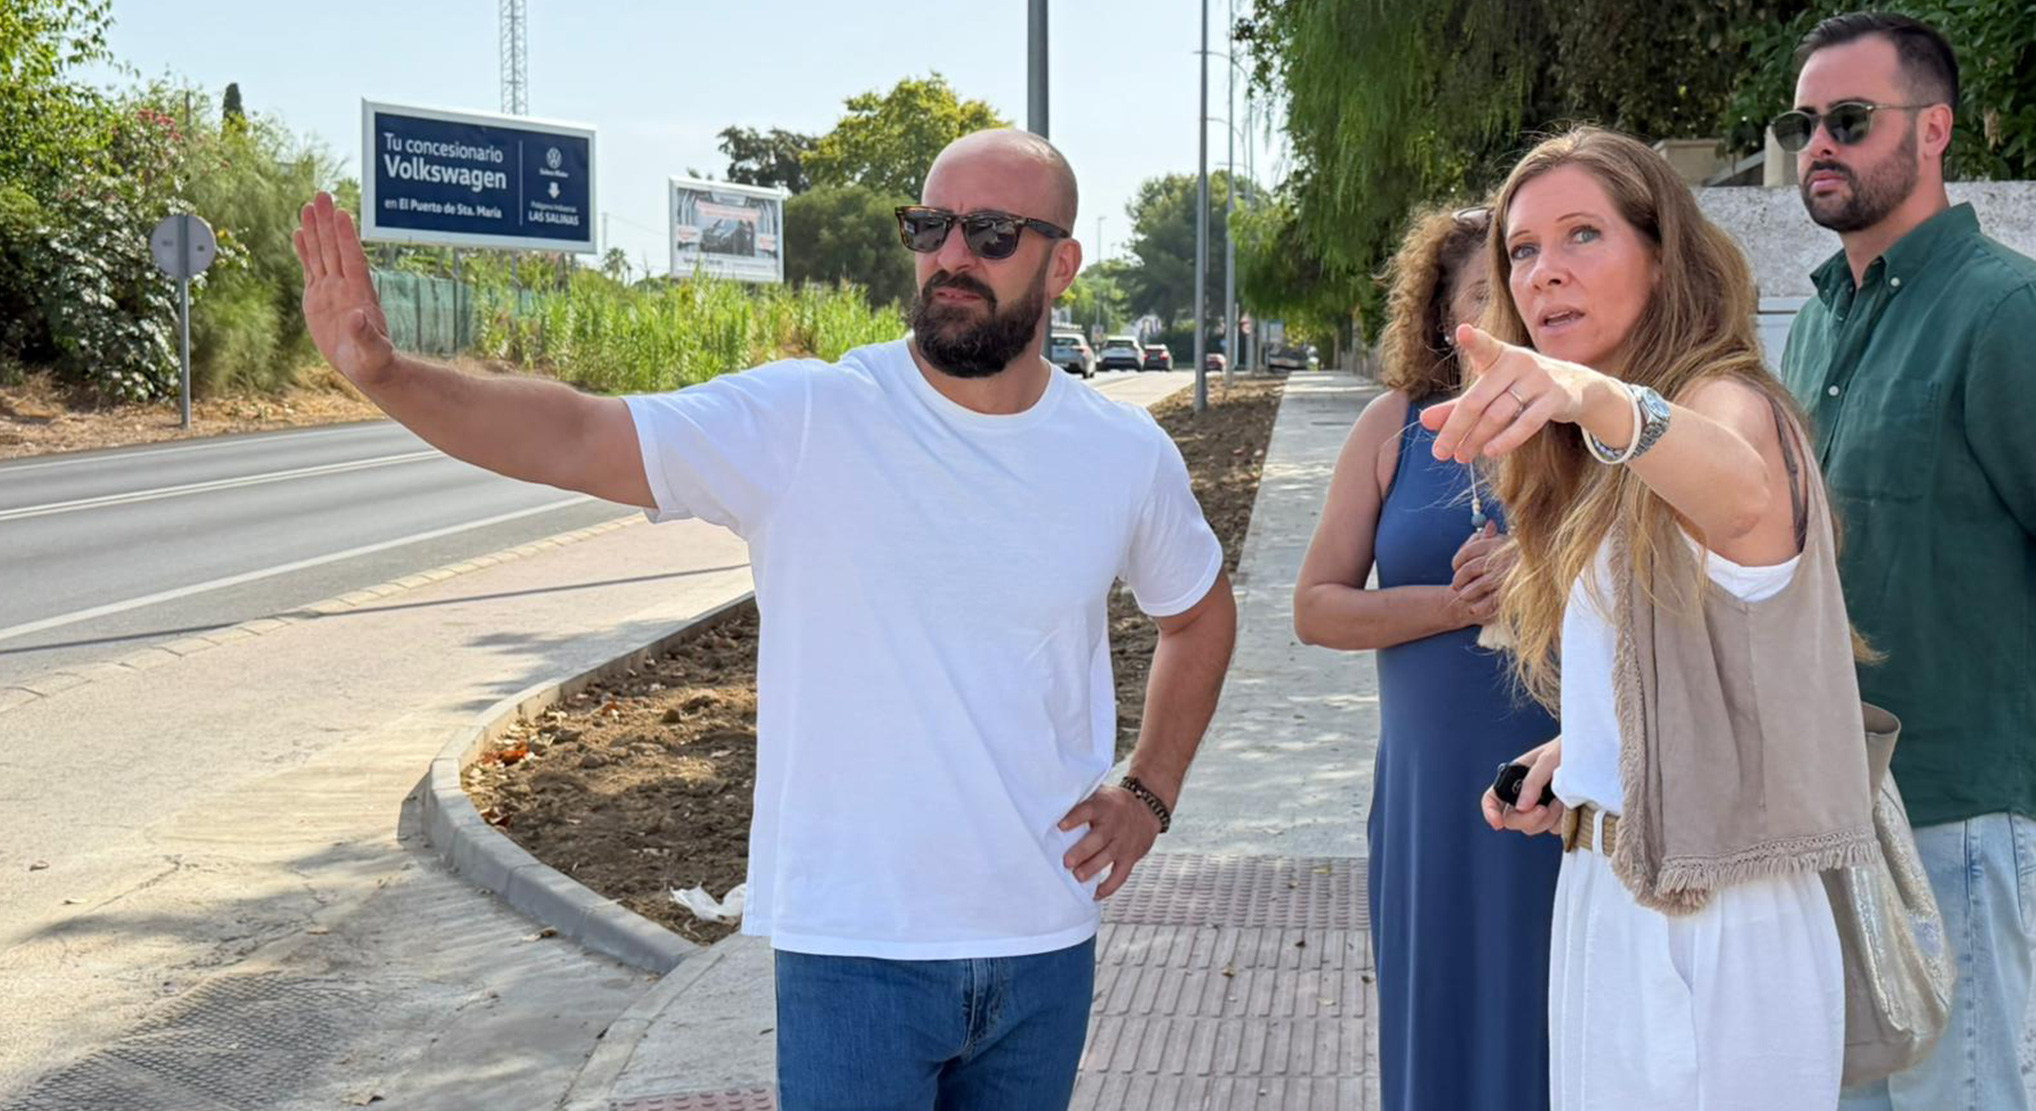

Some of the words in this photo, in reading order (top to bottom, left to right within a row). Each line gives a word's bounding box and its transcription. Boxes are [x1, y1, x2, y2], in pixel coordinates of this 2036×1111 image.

[383, 132, 402, 151] Tu
[405, 139, 503, 163] concesionario
[384, 153, 507, 193] Volkswagen
[384, 199, 397, 209] en
[399, 198, 408, 210] El
[410, 200, 442, 214] Puerto
[444, 202, 456, 215] de
[457, 203, 475, 216] Sta.
[528, 210, 544, 223] LAS
[545, 212, 579, 226] SALINAS
